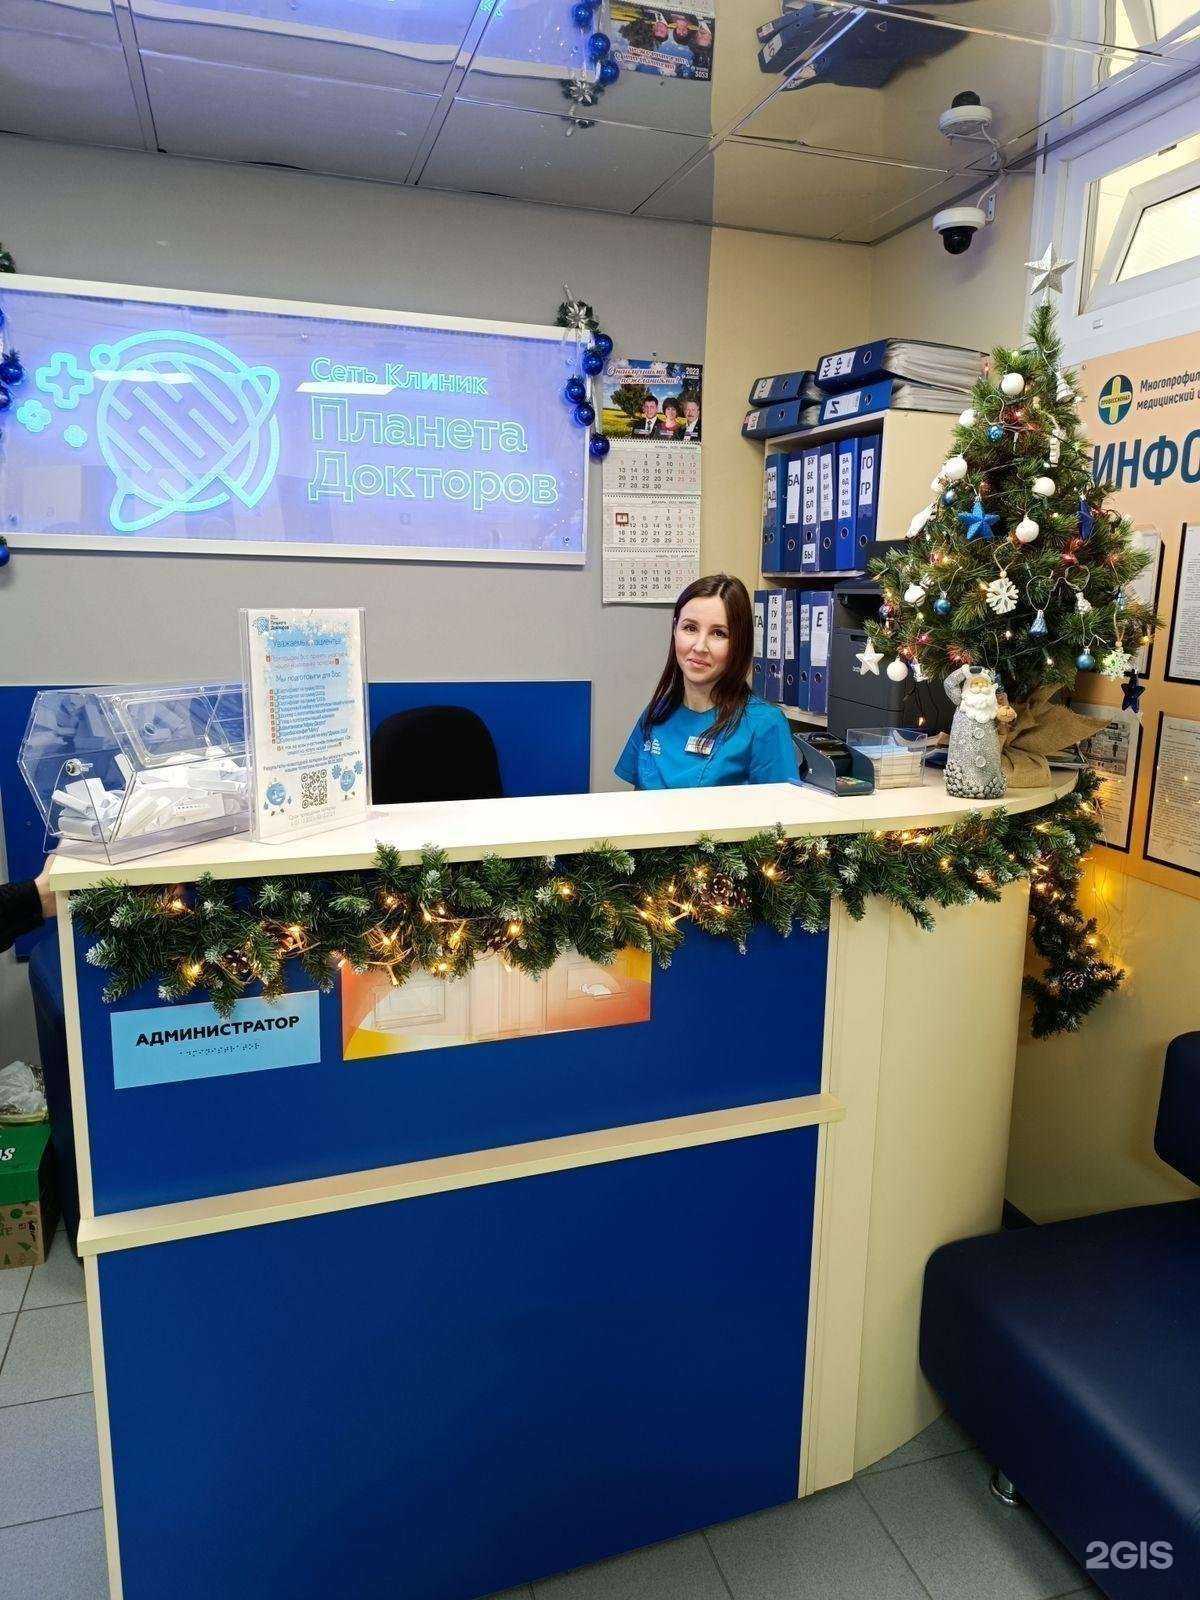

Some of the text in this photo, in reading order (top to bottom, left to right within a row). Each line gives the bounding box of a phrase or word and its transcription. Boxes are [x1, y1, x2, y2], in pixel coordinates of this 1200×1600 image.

[310, 357, 488, 396] Сеть Клиник
[1137, 388, 1195, 410] медицинский
[310, 395, 528, 453] Планета
[308, 450, 559, 512] Докторов
[788, 474, 800, 486] БА
[135, 1015, 300, 1046] АДМИНИСТРАТОР
